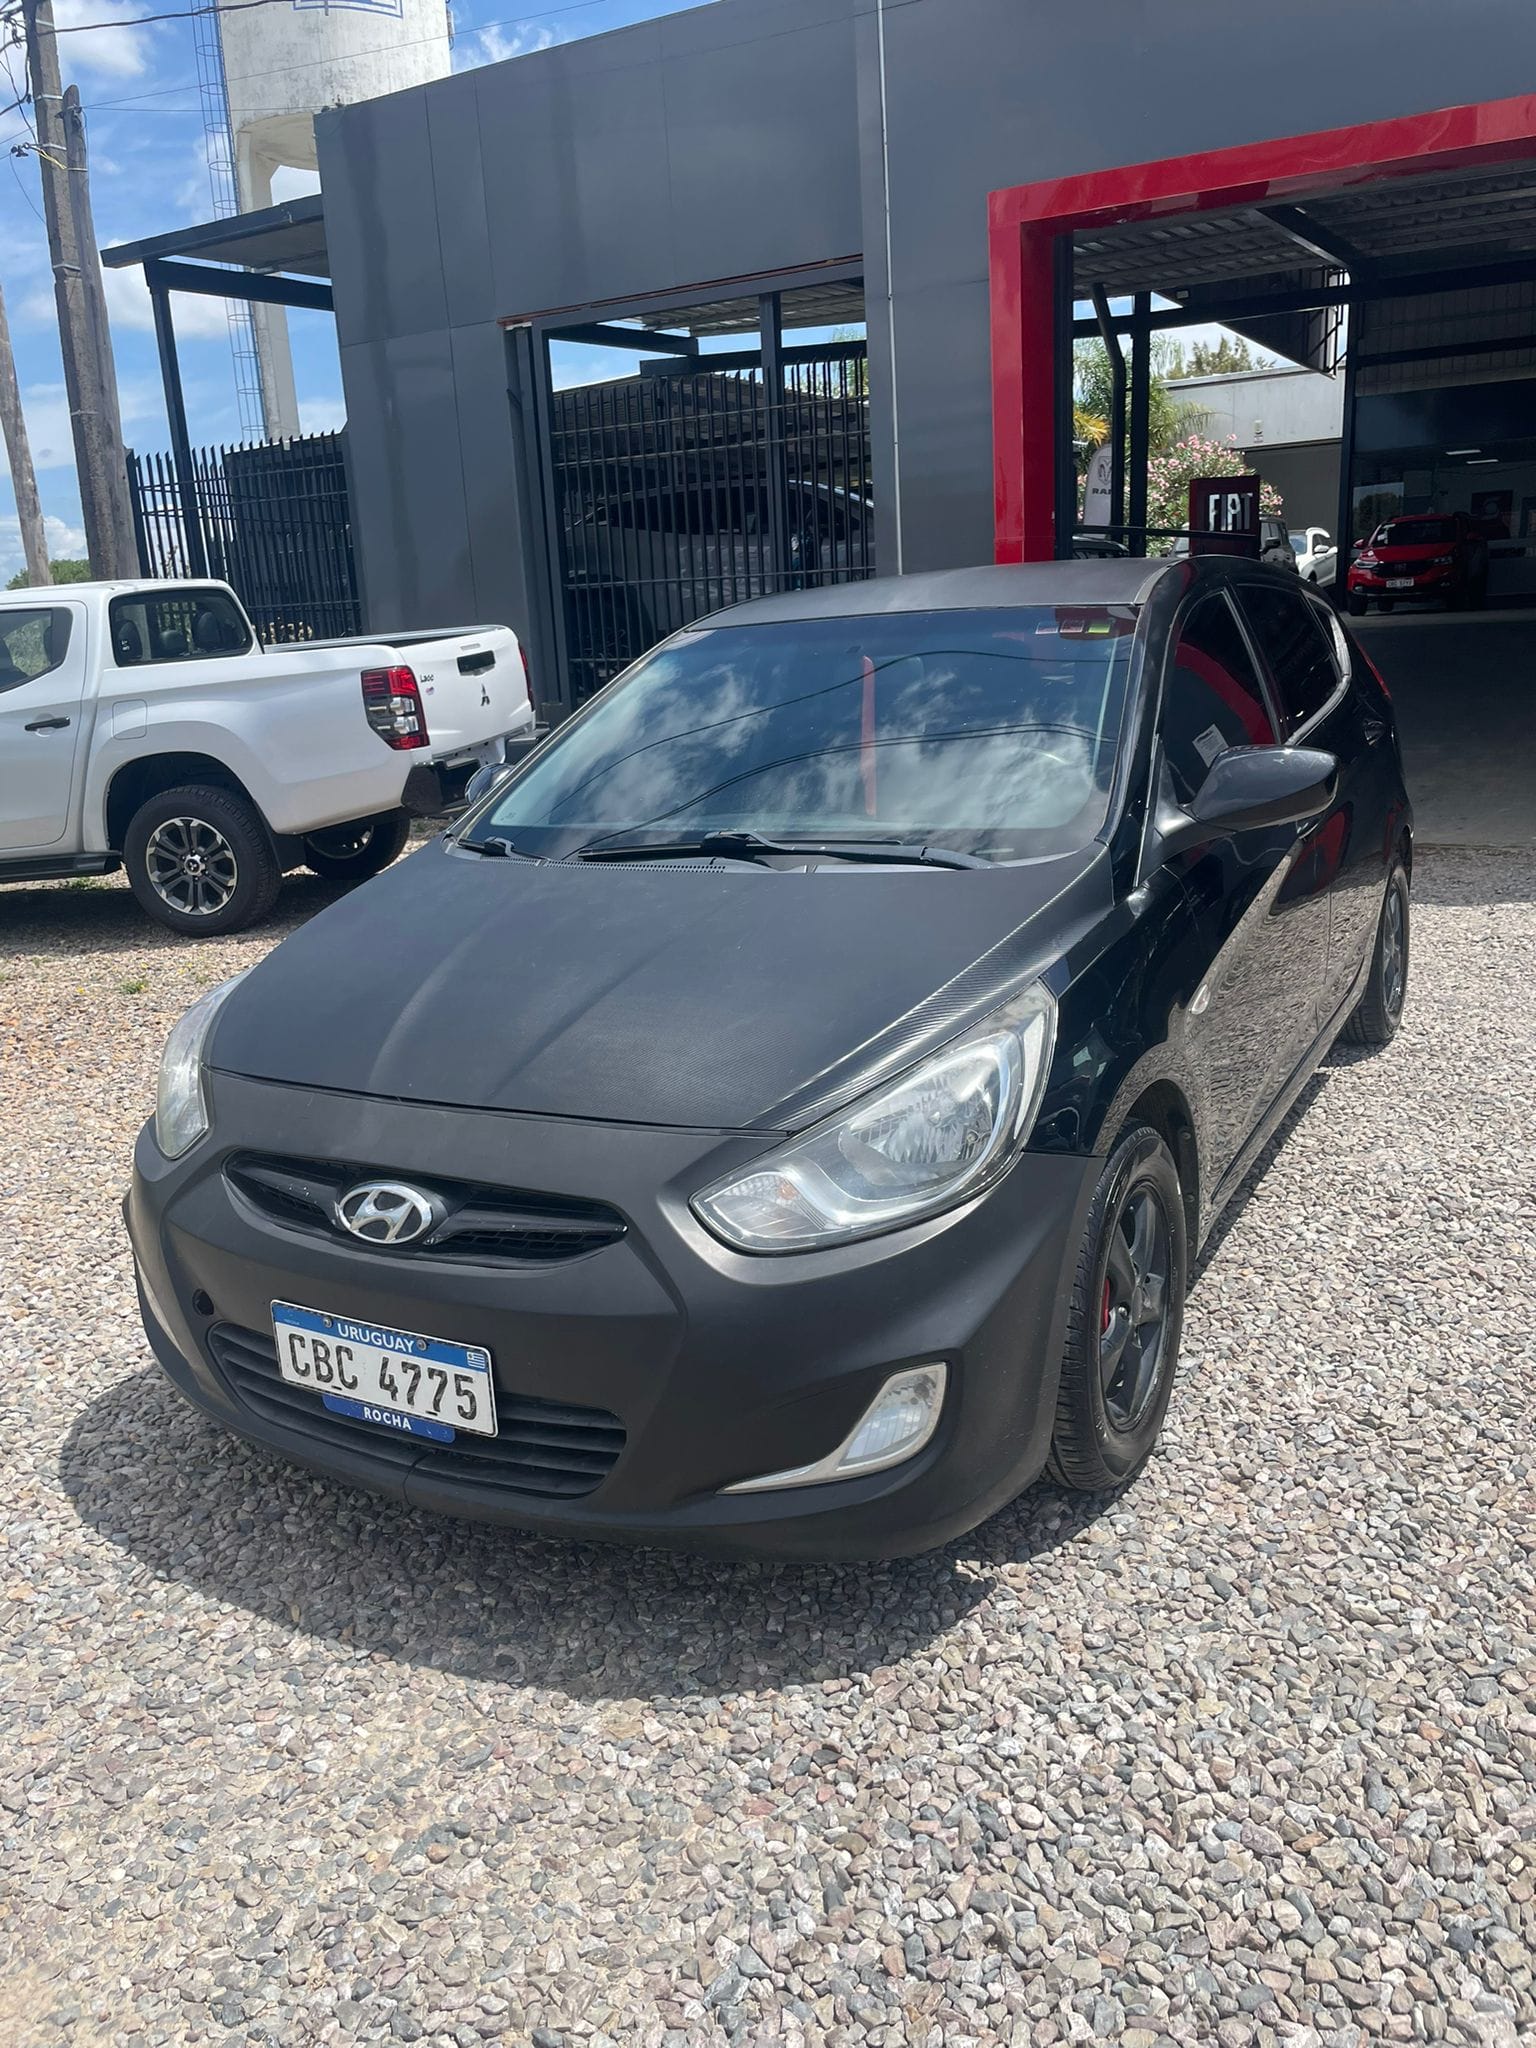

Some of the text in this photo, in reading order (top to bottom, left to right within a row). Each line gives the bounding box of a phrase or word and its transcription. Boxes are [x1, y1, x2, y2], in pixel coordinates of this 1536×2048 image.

[1209, 493, 1254, 531] FIAT
[337, 1323, 415, 1353] URUGUAY
[288, 1333, 477, 1421] CBC 4775
[363, 1407, 412, 1431] ROCHA
